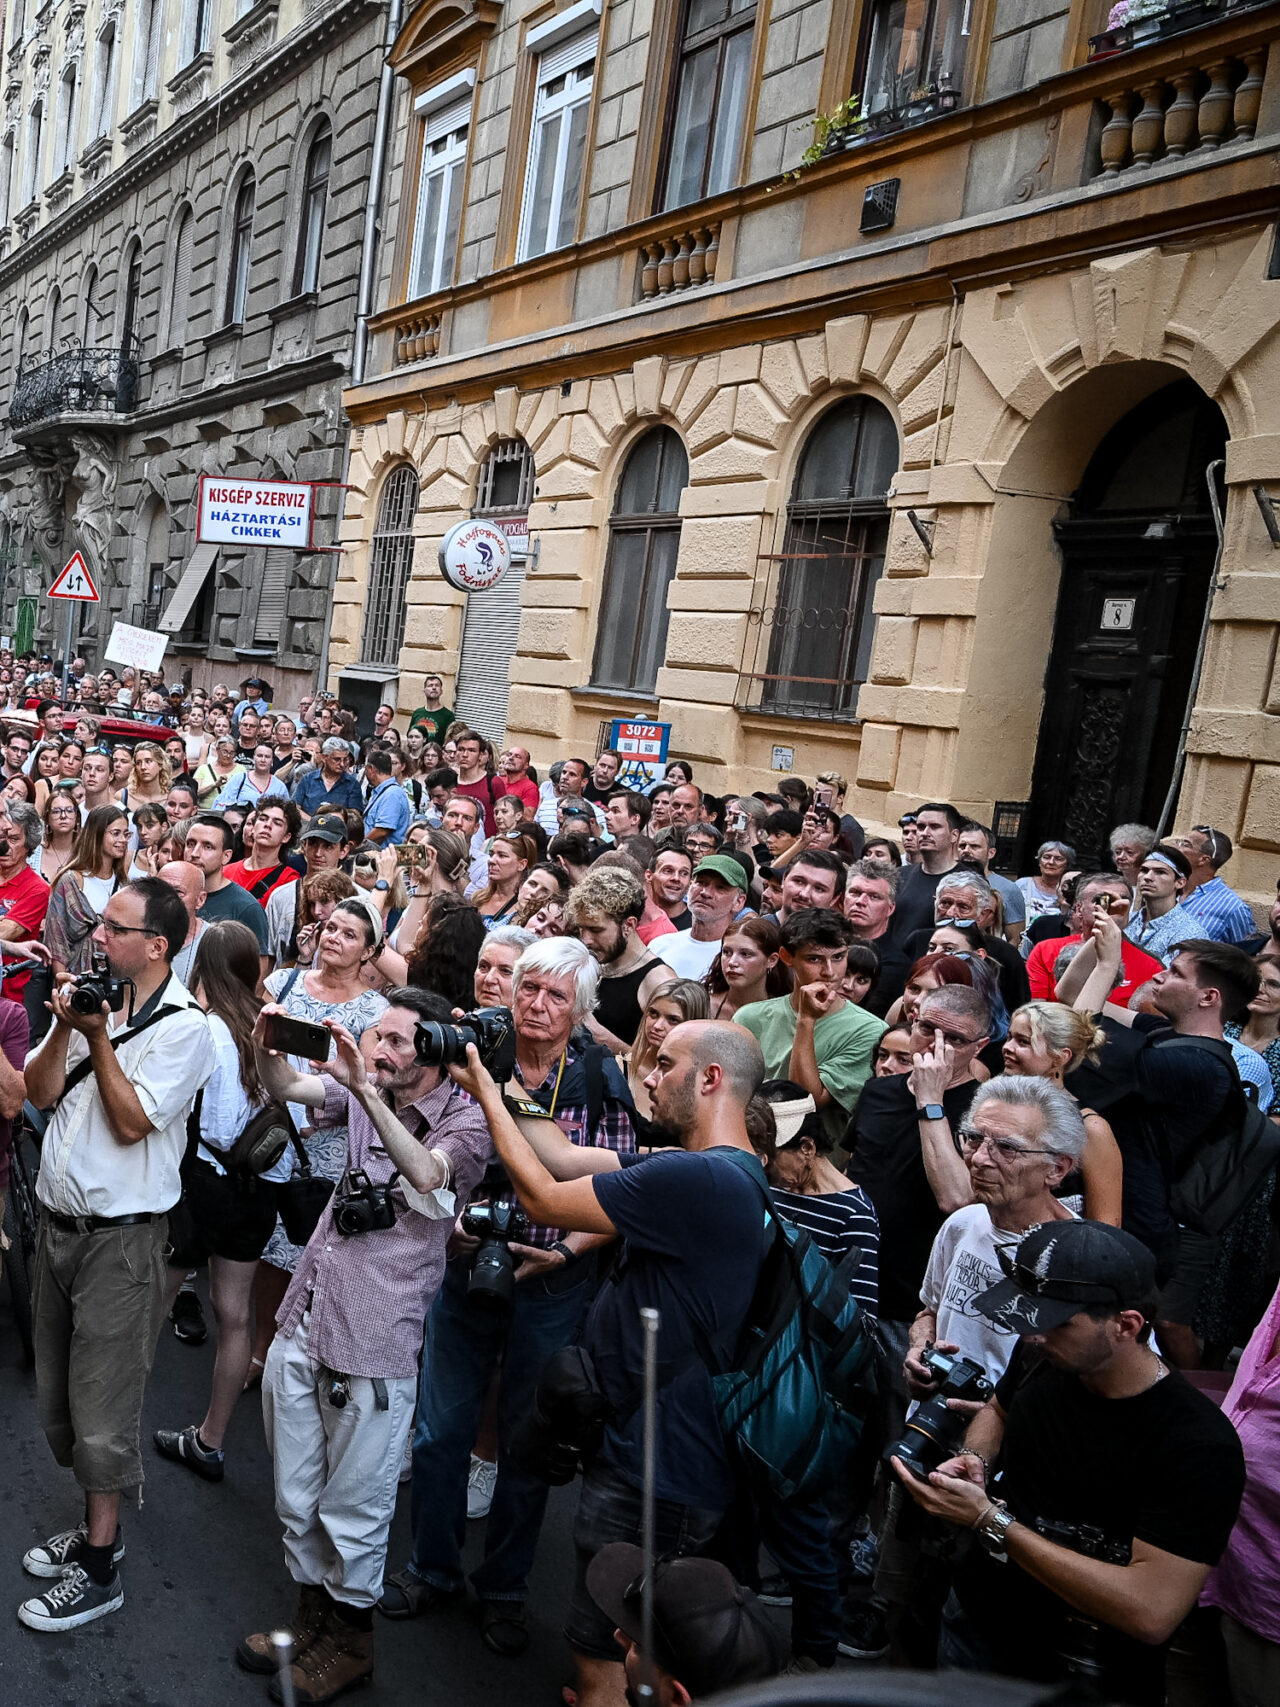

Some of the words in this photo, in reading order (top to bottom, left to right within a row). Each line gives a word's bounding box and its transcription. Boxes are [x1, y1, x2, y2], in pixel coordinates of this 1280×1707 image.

[209, 485, 252, 504] KISGÉP
[255, 490, 306, 508] SZERVIZ
[210, 509, 301, 526] HÁZTARTÁSI
[231, 525, 282, 538] CIKKEK
[1113, 608, 1121, 625] 8
[626, 724, 656, 737] 3072
